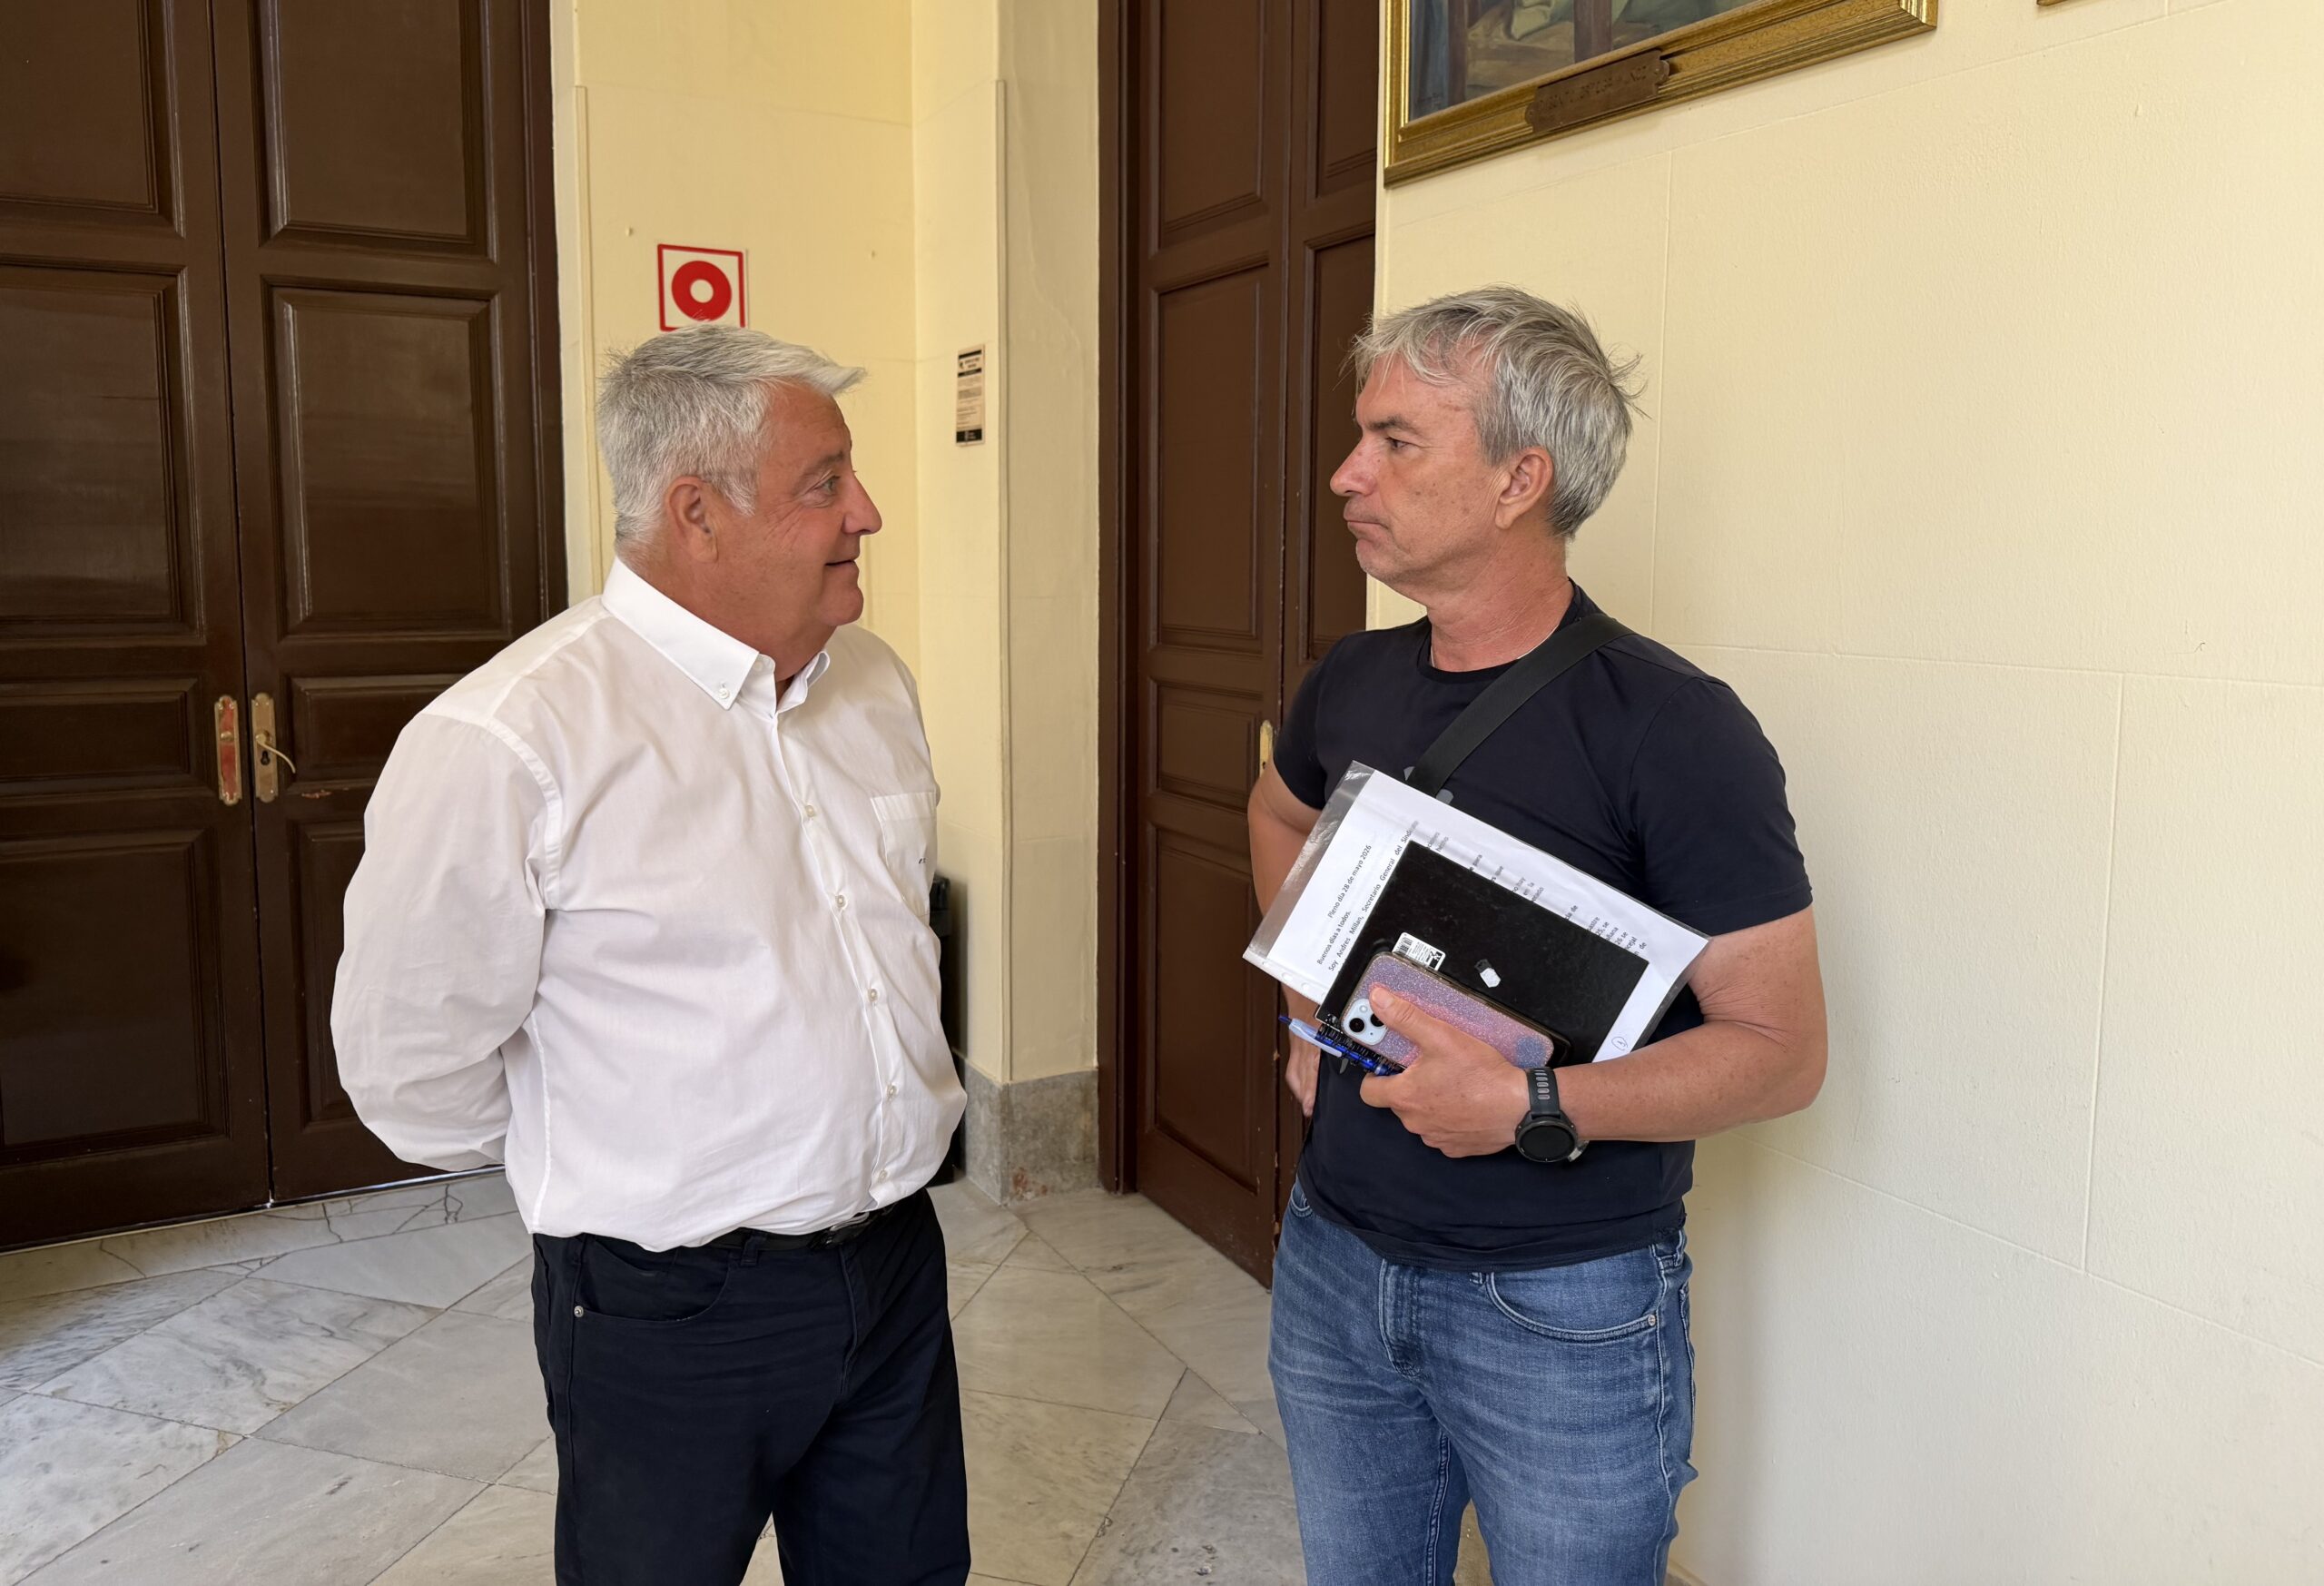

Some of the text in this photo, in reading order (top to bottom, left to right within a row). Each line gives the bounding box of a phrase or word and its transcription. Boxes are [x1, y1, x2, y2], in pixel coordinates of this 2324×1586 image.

[1327, 901, 1340, 918] Pleno
[1342, 883, 1350, 892] 28
[1352, 860, 1364, 876] mayo
[1360, 844, 1372, 860] 2026
[1361, 884, 1381, 912] Secretario
[1379, 858, 1395, 881] General
[1394, 845, 1403, 855] del
[1316, 944, 1332, 965] Buenos
[1337, 911, 1351, 928] todos.
[1328, 960, 1338, 971] Soy
